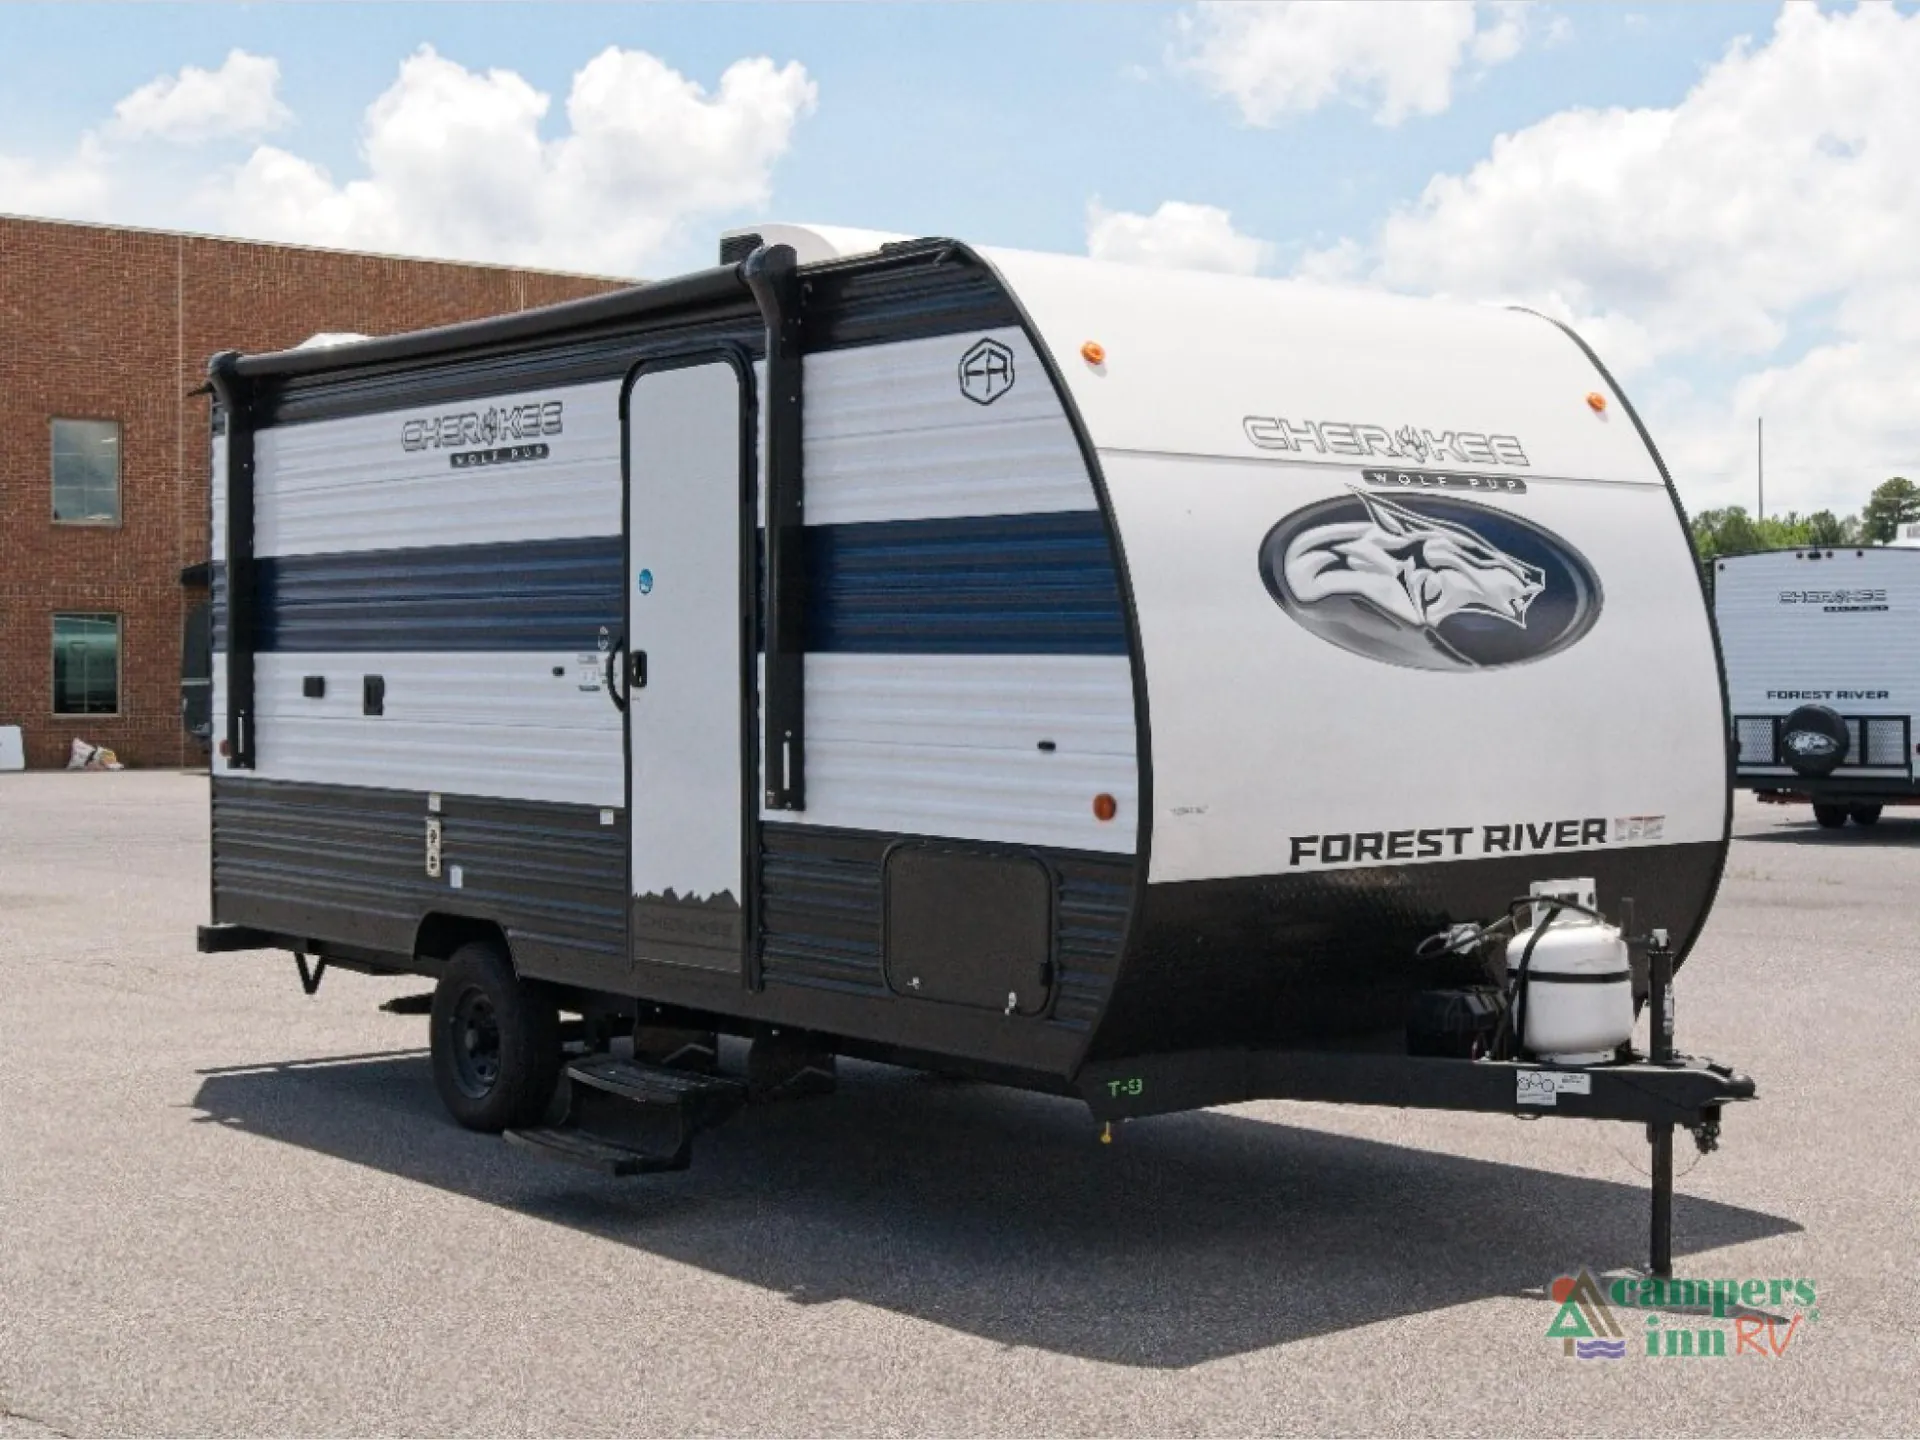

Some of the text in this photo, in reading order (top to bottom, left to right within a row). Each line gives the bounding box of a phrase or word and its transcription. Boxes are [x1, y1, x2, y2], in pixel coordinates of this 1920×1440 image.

[402, 401, 562, 451] CHEROKEE
[1243, 415, 1530, 467] CHEROKEE
[1373, 472, 1516, 491] WOLF PUP
[1766, 690, 1889, 699] FOREST RIVER
[1289, 826, 1473, 865] FOREST
[1482, 817, 1608, 853] RIVER
